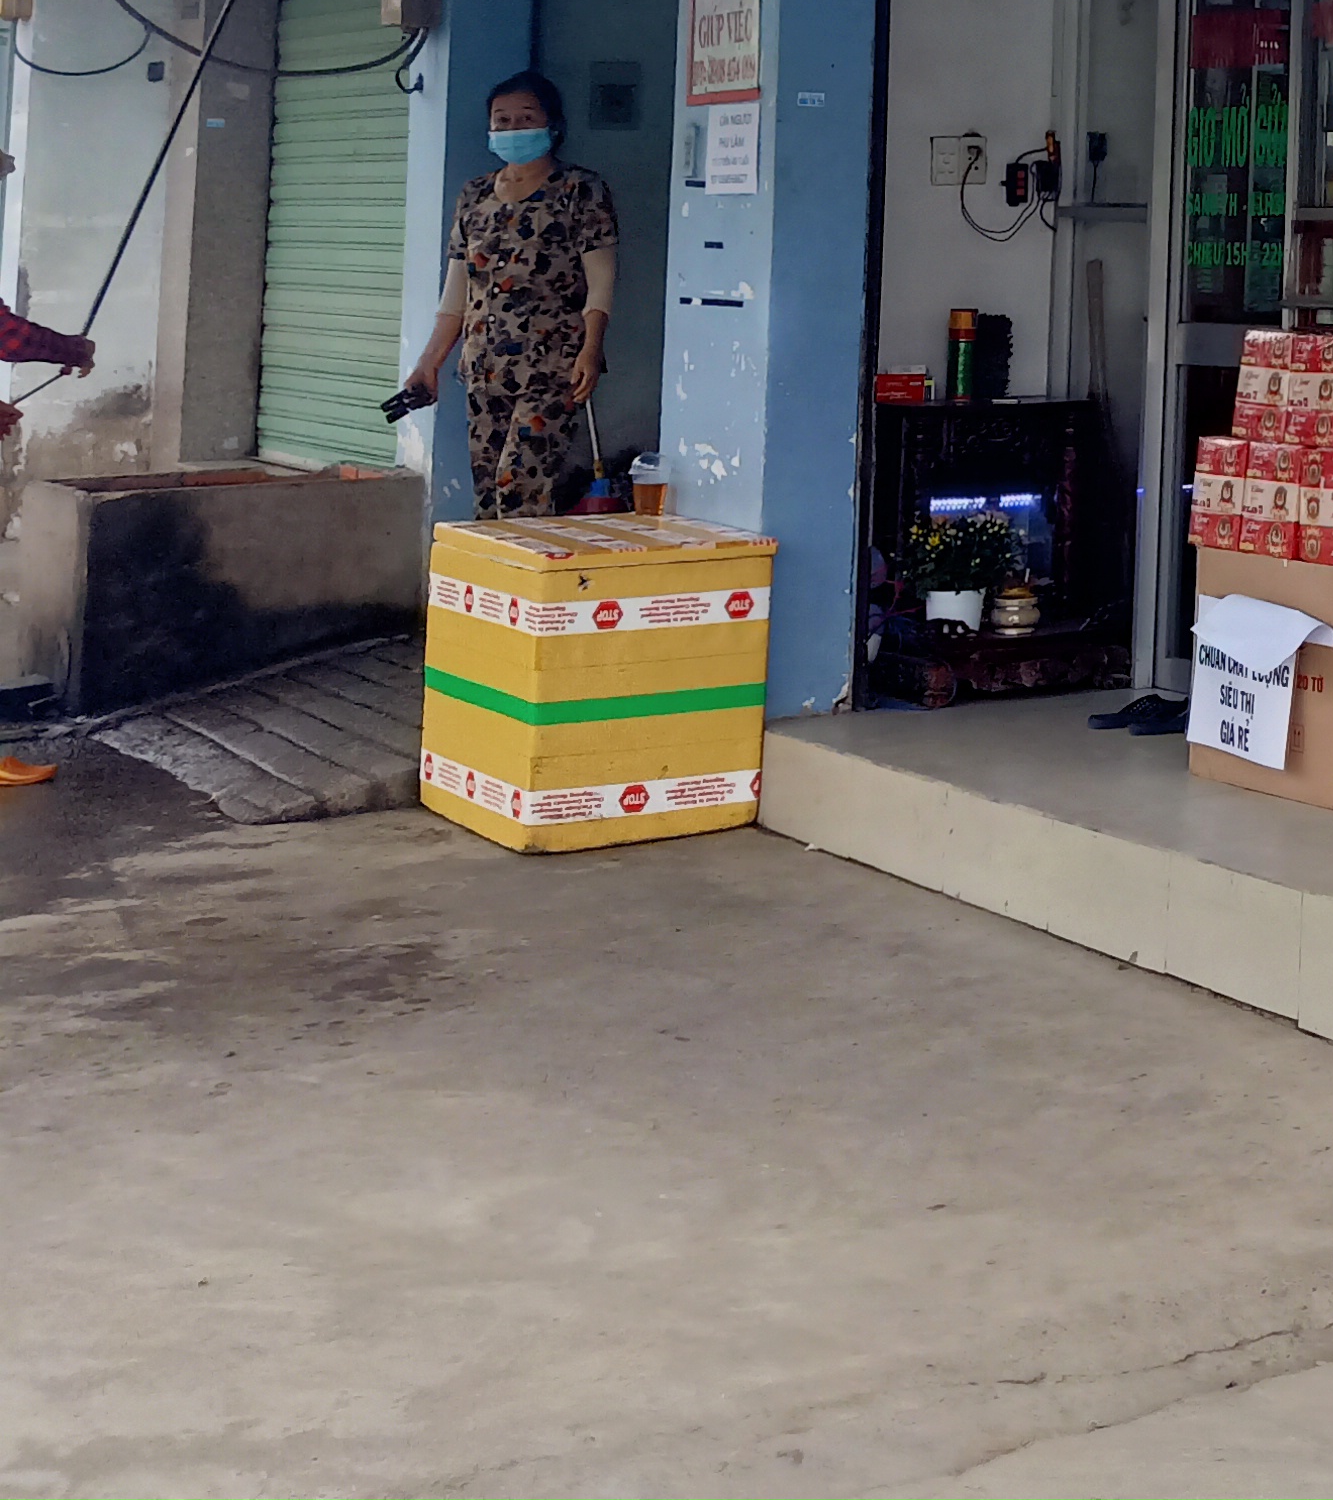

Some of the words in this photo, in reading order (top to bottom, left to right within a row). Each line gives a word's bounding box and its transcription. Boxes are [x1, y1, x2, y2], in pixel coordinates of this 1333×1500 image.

[728, 598, 752, 612] STOP
[595, 608, 621, 622] STOP
[1219, 680, 1239, 710] SIÊU
[1240, 690, 1256, 721] THỊ
[1219, 716, 1235, 748] GIÁ
[1237, 718, 1250, 753] RẺ
[622, 792, 648, 806] STOP
